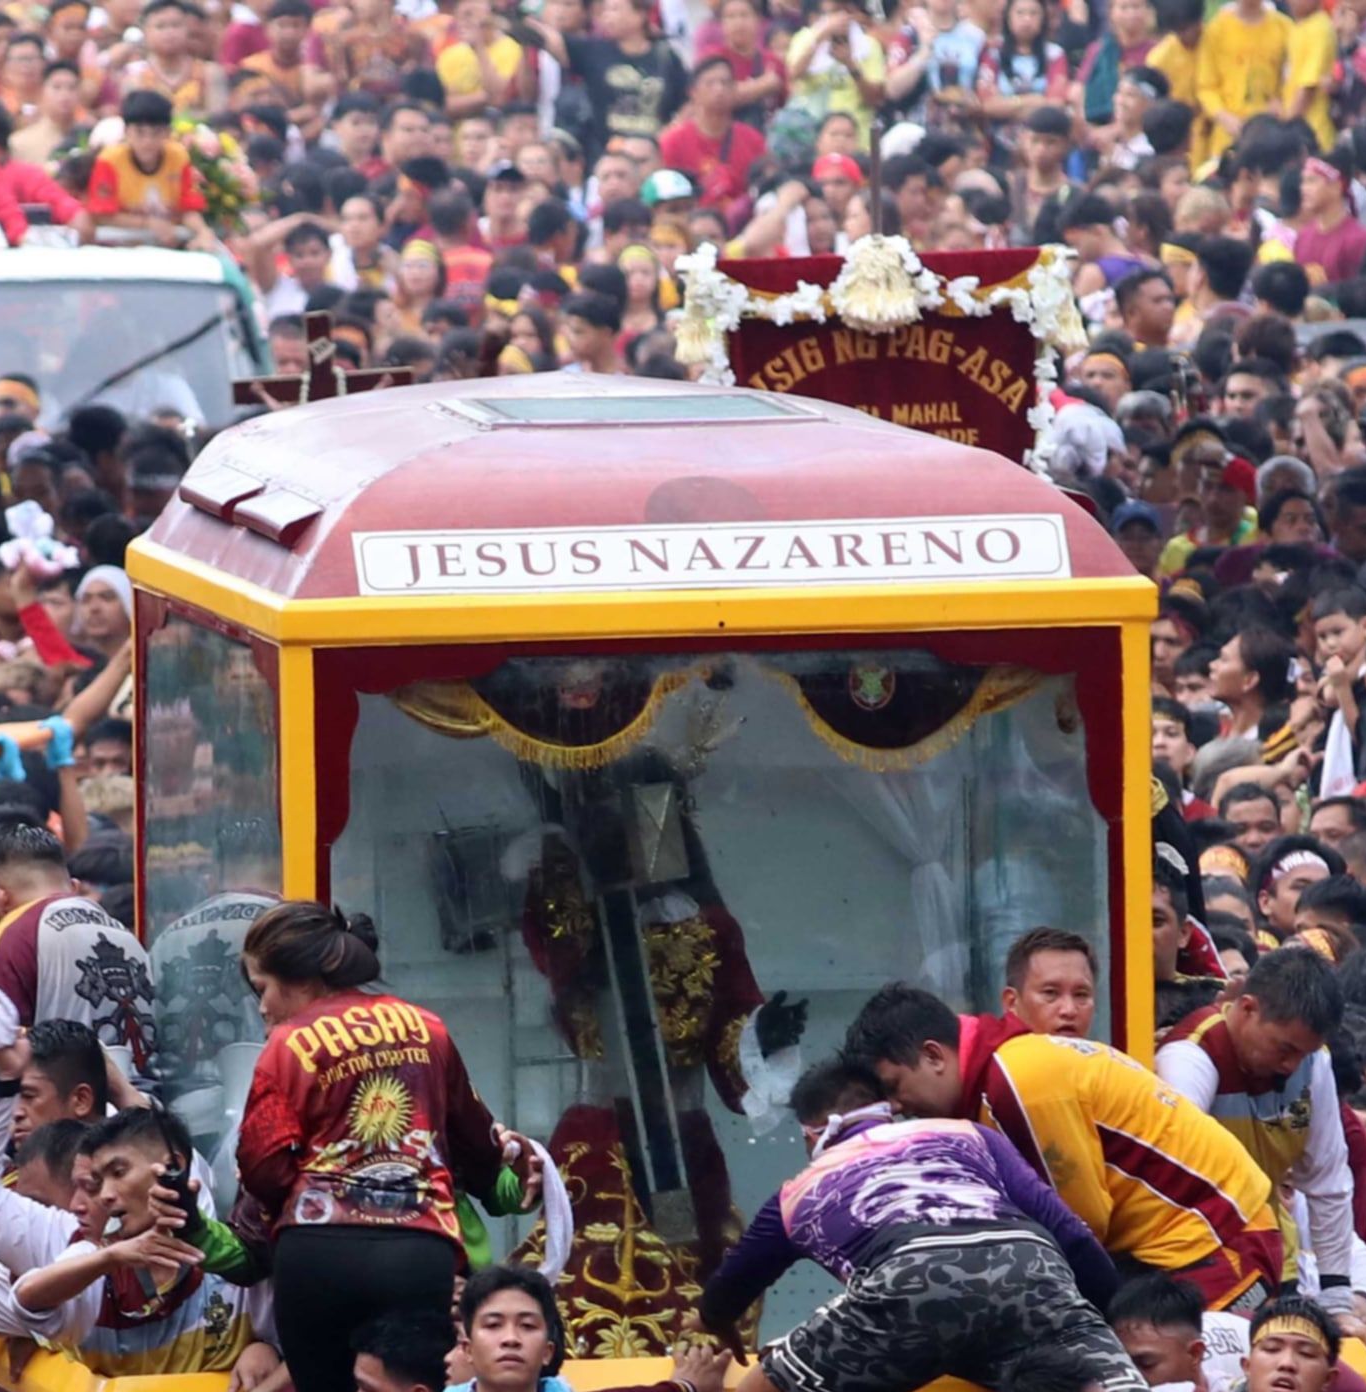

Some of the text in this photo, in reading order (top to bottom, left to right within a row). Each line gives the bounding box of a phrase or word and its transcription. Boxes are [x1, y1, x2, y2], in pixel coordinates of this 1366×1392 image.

[833, 330, 877, 364] NG
[887, 327, 1029, 413] PAG-ASA
[892, 400, 962, 424] MAHAL
[405, 526, 1021, 587] JESUS NAZARENO
[285, 1001, 431, 1074] PASAY
